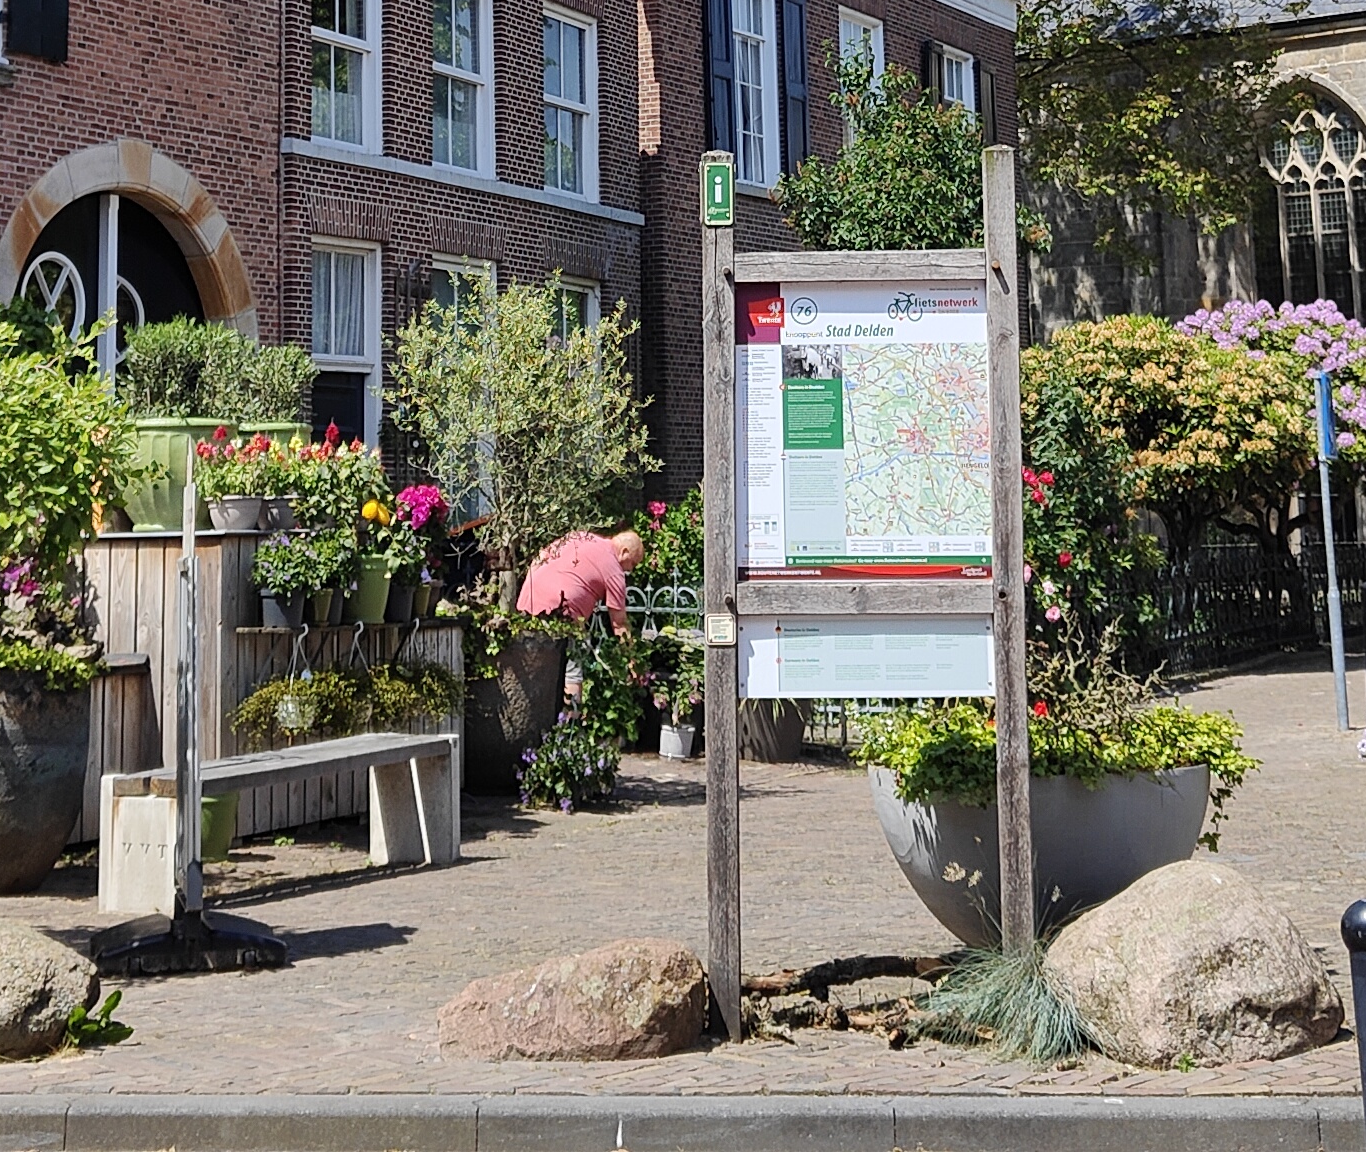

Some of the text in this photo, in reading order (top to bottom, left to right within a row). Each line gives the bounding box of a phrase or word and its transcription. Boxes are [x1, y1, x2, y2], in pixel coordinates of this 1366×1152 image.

[796, 305, 812, 317] 76
[825, 323, 852, 338] Stad
[854, 323, 895, 337] Delden
